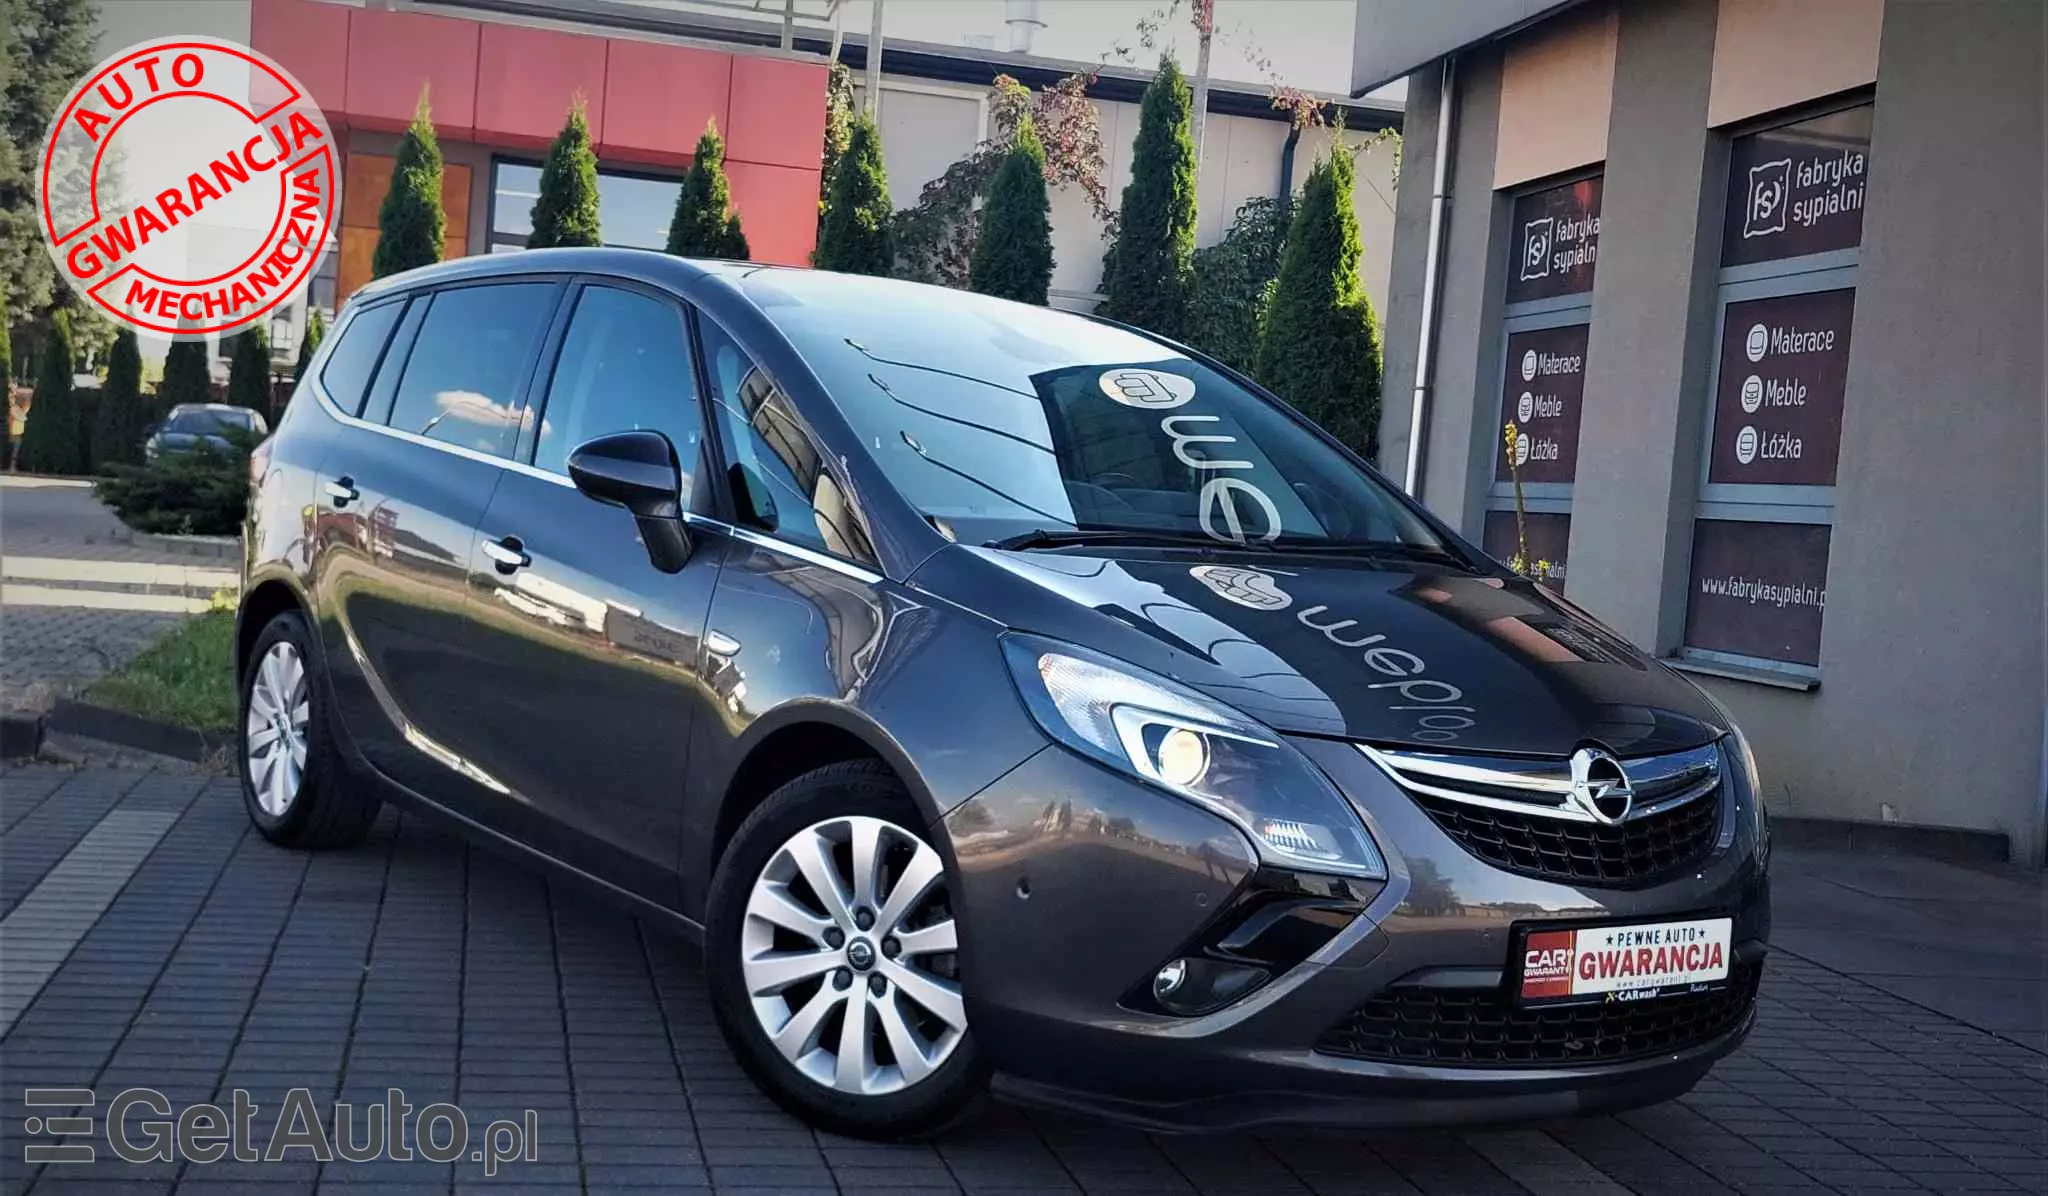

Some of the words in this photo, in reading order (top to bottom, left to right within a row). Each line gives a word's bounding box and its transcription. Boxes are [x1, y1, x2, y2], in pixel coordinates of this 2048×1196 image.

[1796, 149, 1864, 189] fabryka
[1793, 181, 1864, 227] sypialni
[1556, 213, 1600, 243] fabryka
[1554, 241, 1596, 274] sypialn
[1770, 326, 1834, 355] Materace
[1538, 352, 1581, 376] Materace
[1534, 394, 1562, 417] Meble
[1765, 378, 1806, 407] Meble
[1530, 437, 1558, 460] Łóżka
[1761, 431, 1802, 459] Łóżka
[1617, 930, 1661, 946] PEWNE
[1665, 927, 1695, 944] AUTO
[1524, 949, 1567, 967] CAR
[1578, 942, 1724, 981] GWARANCJA
